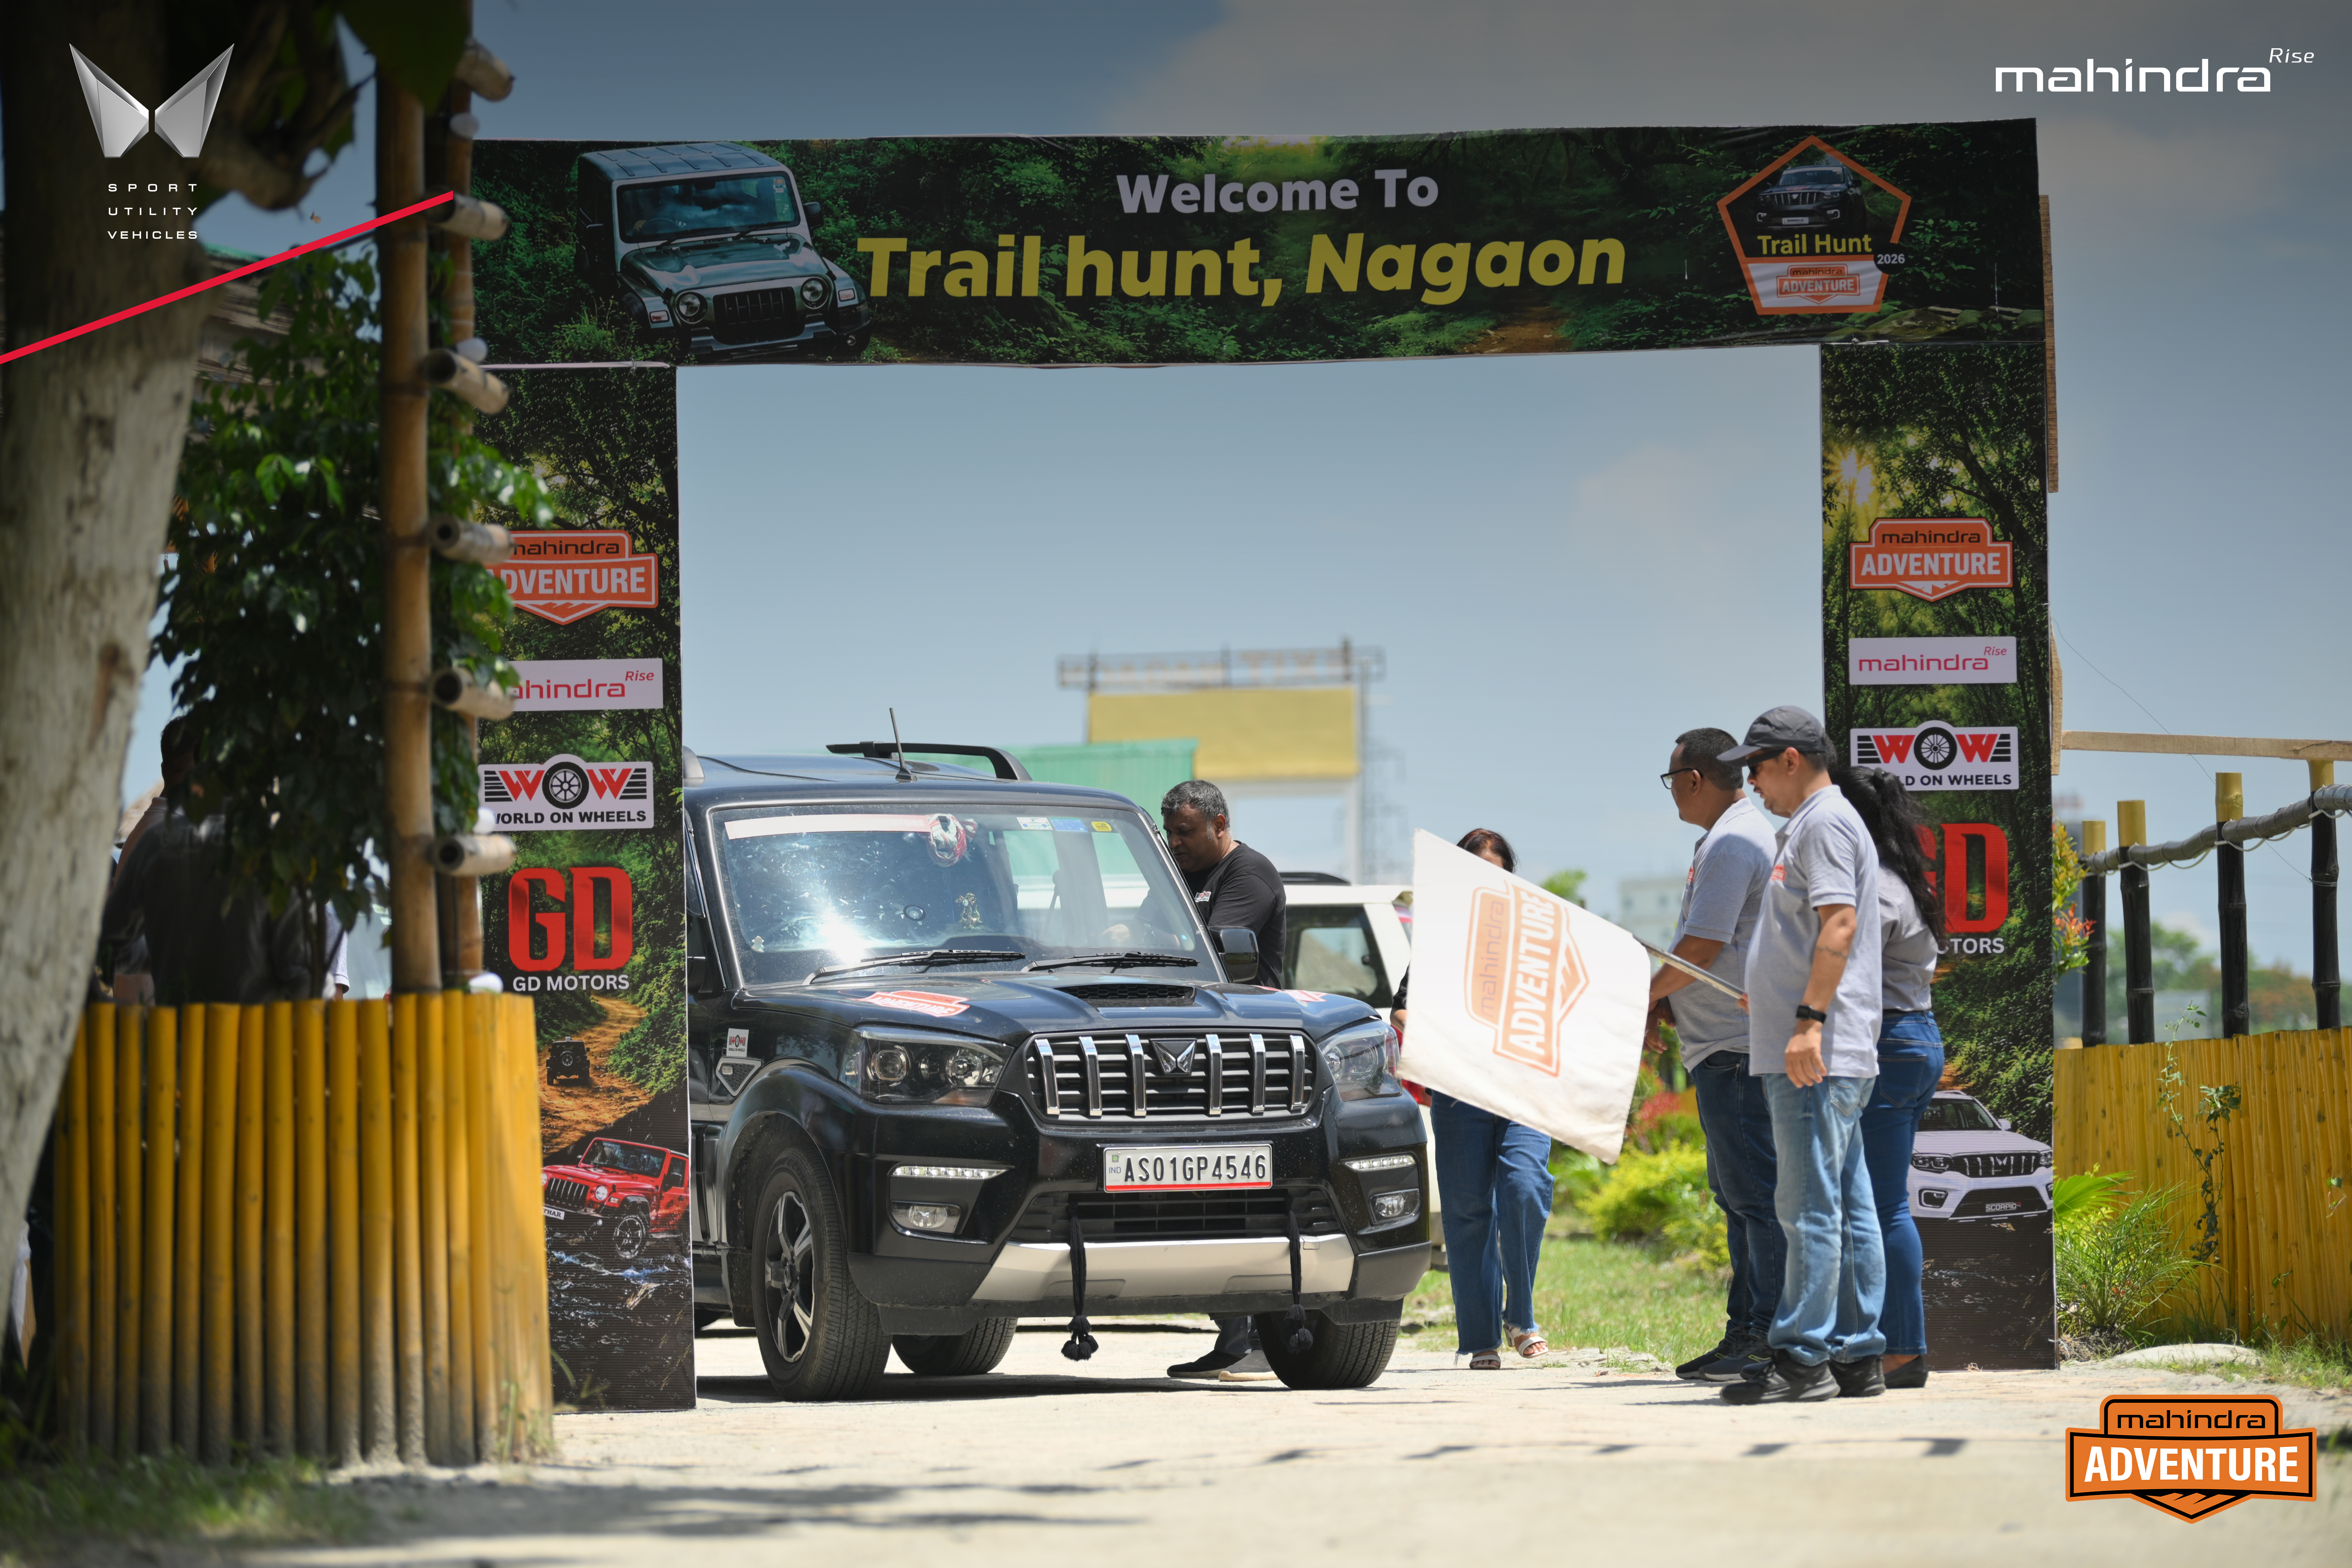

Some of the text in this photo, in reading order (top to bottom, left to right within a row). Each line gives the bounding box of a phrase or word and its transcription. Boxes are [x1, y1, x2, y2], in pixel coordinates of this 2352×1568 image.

[1116, 169, 1438, 214] Welcome To
[1757, 234, 1872, 254] Trail Hunt
[857, 233, 1625, 306] Trail hunt, Nagaon
[1877, 254, 1905, 264] 2026
[1782, 279, 1854, 292] ADVENTURE
[1882, 530, 1981, 544] mahindra
[1861, 553, 2001, 576] ADVENTURE
[486, 567, 646, 594] DVENTURE
[1859, 646, 2007, 671] mahindra Rise
[513, 670, 654, 700] ahindra Rise
[1920, 775, 1942, 786] ON
[1948, 774, 2012, 785] WHEELS
[550, 812, 573, 823] ON
[579, 810, 647, 822] WHEELS
[508, 866, 633, 972] GD
[1480, 901, 1504, 1018] mahindra
[513, 975, 630, 991] GD MOTORS
[1508, 890, 1555, 1055] ADVENTURE
[1124, 1155, 1266, 1182] AS01GP4546
